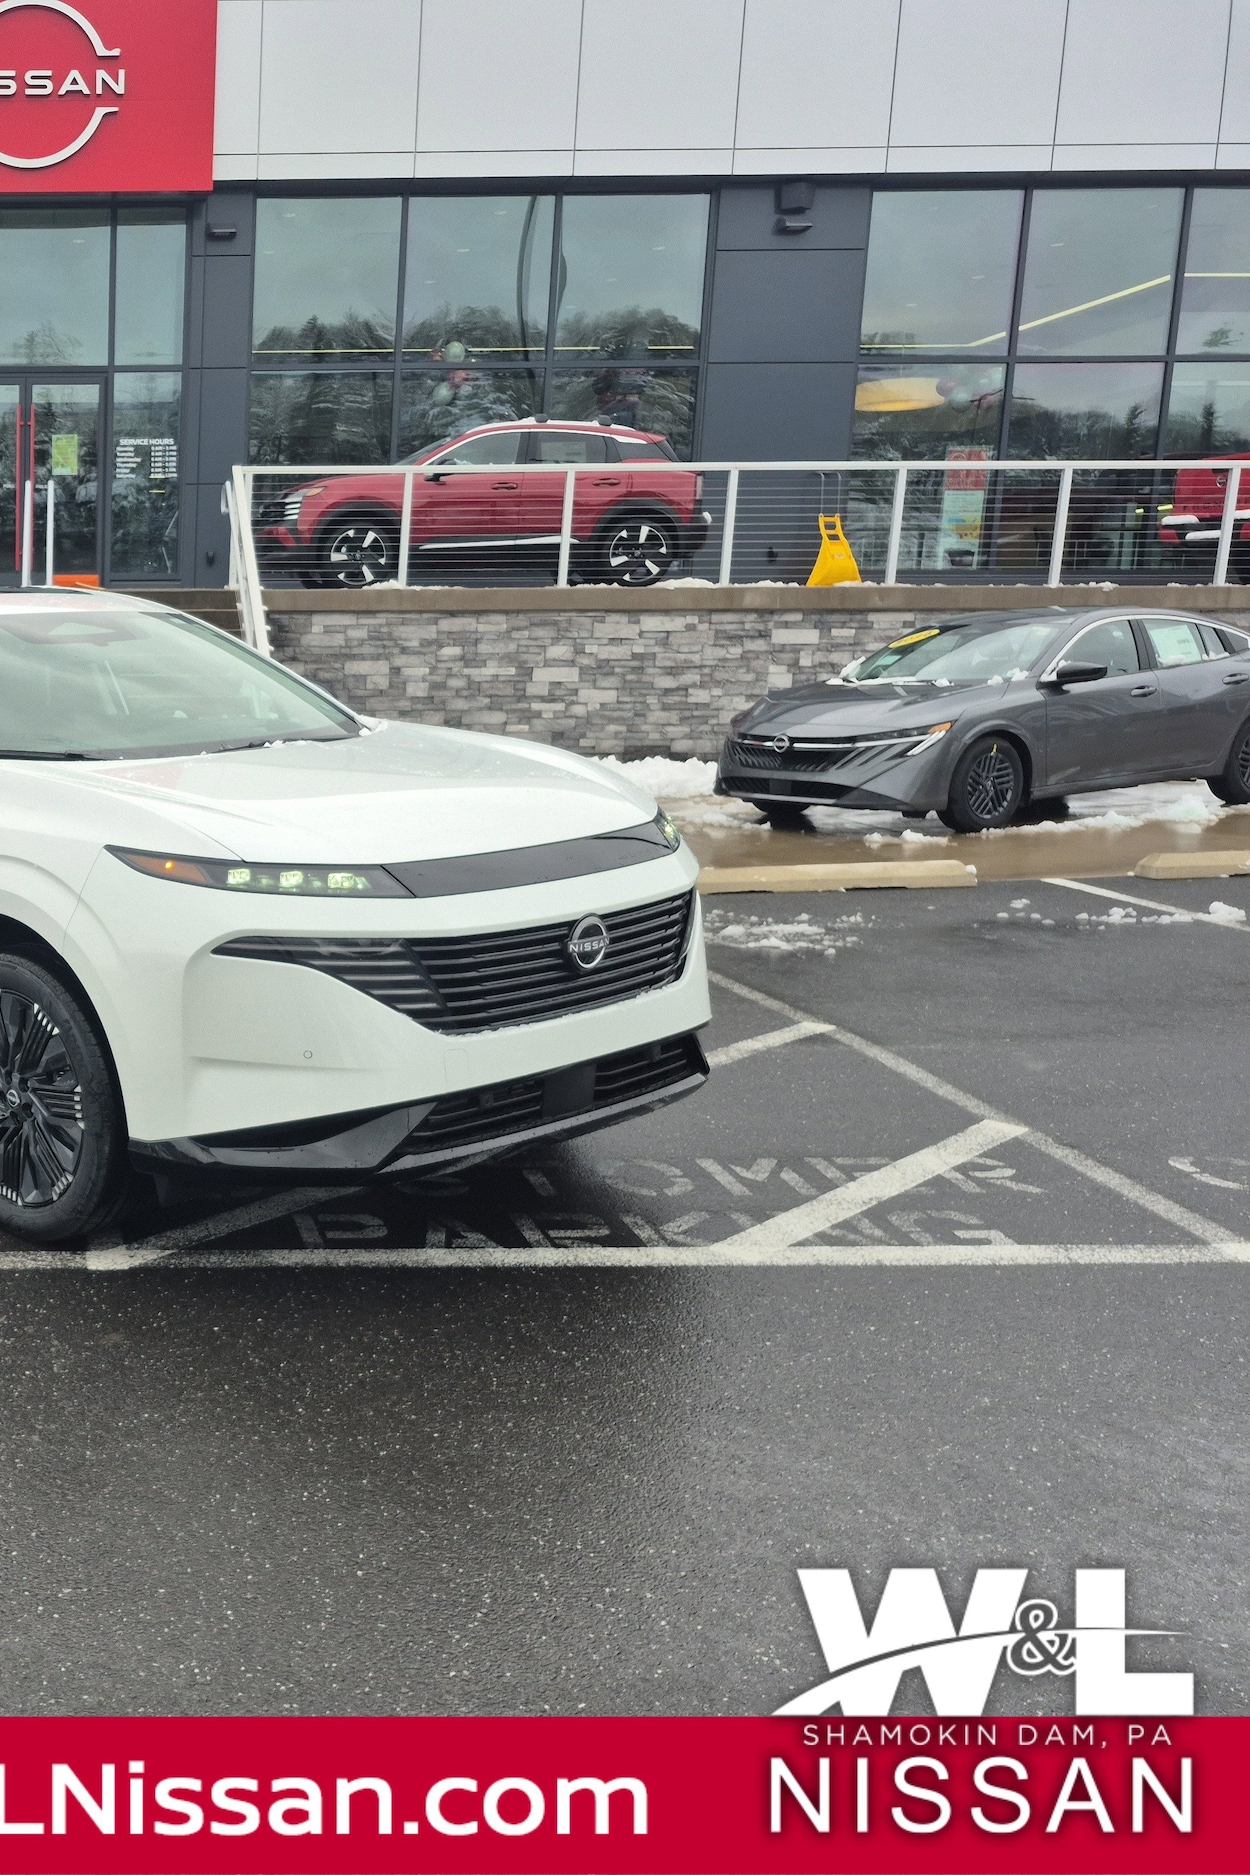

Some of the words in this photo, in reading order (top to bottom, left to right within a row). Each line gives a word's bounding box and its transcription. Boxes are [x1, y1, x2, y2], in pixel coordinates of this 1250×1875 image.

[119, 438, 149, 446] SERVICE
[149, 437, 175, 445] HOURS
[569, 937, 610, 953] NISSAN
